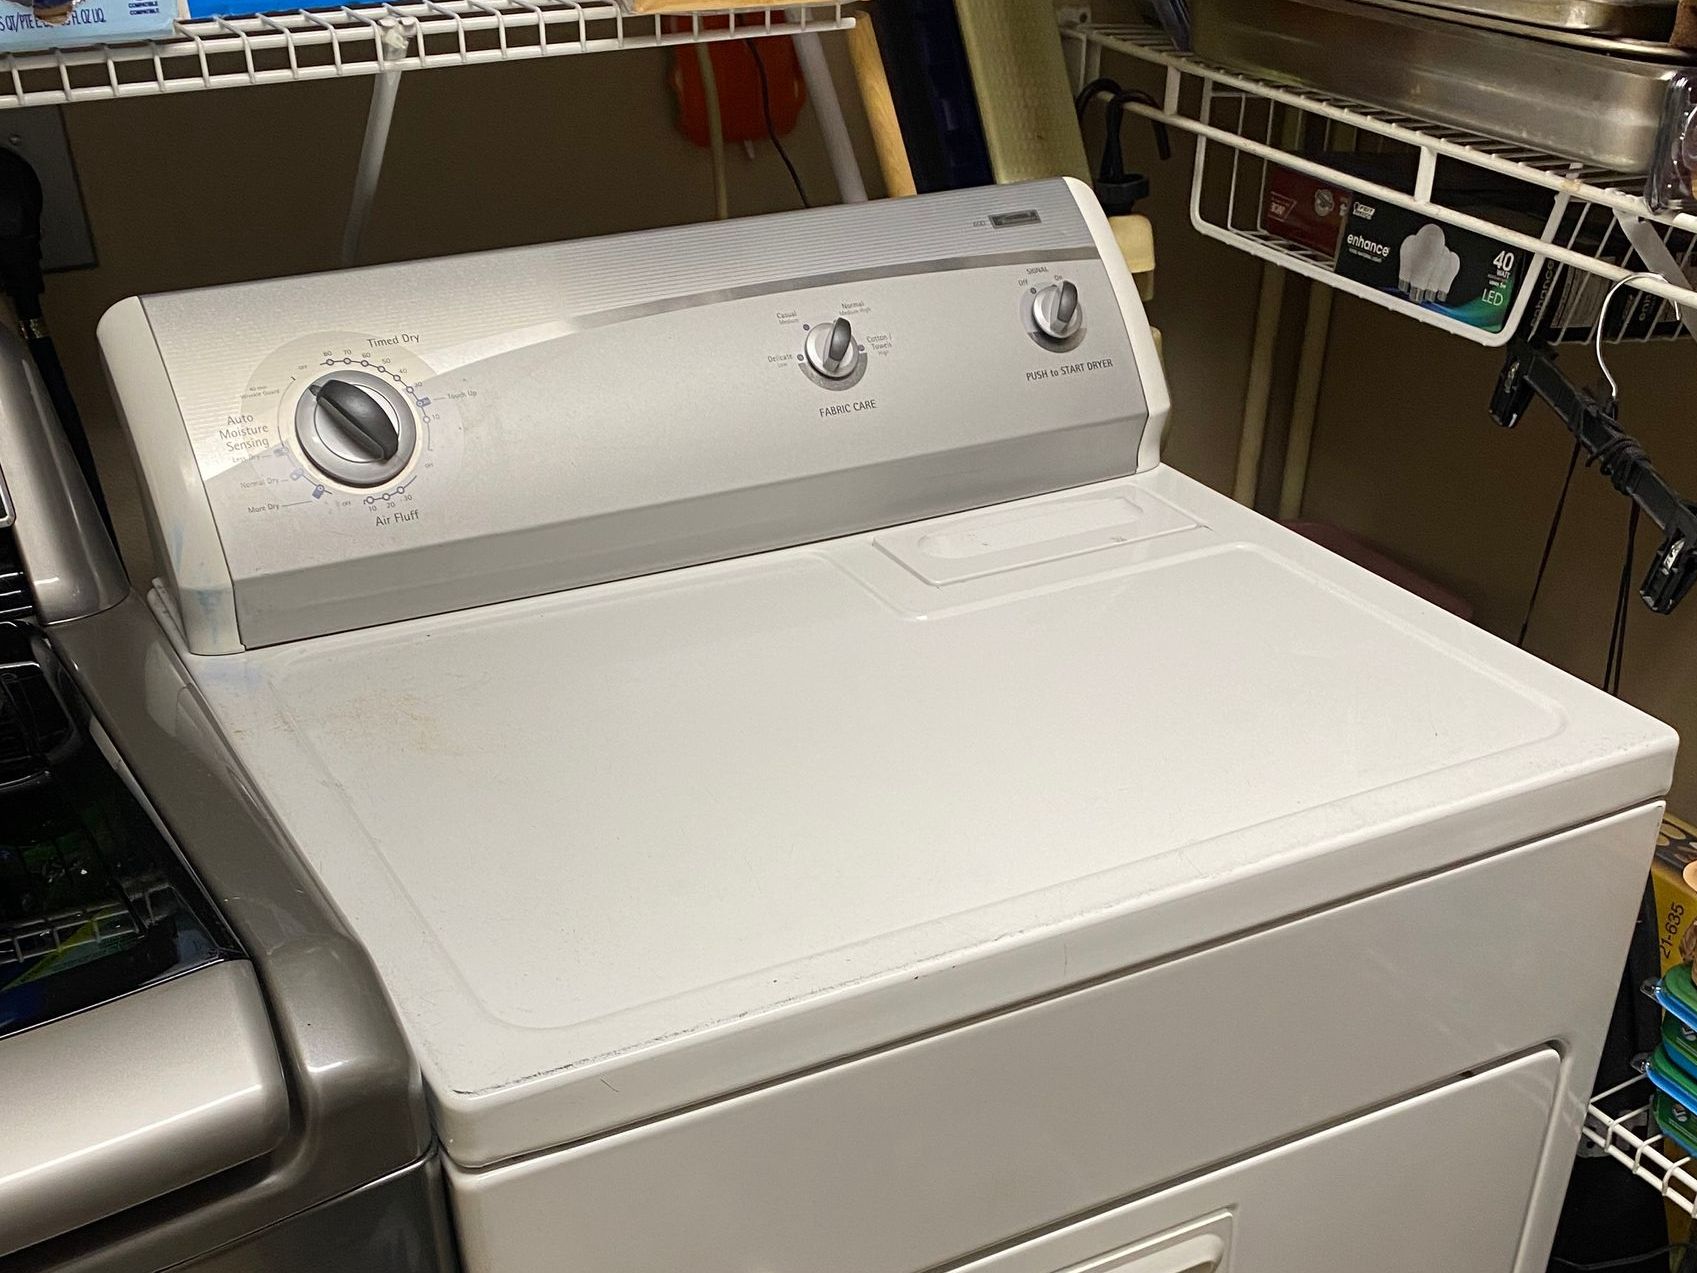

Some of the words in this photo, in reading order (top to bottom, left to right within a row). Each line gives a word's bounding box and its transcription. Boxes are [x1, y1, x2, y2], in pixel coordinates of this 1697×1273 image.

[1346, 233, 1390, 257] enhance
[1492, 250, 1516, 272] 40
[1481, 287, 1504, 306] LED
[367, 336, 399, 349] Timed
[401, 332, 420, 345] Dry
[381, 357, 391, 365] 50
[768, 354, 793, 363] Delicate
[1026, 371, 1049, 381] PUSH
[1050, 369, 1060, 378] to
[1060, 363, 1086, 376] START
[1086, 358, 1114, 372] DRYER
[432, 413, 441, 421] 10
[819, 403, 851, 418] FABRIC
[852, 399, 877, 412] CARE
[227, 414, 254, 426] Auto
[218, 424, 270, 441] Moisture
[226, 437, 270, 453] Sensing
[368, 504, 377, 513] 10
[386, 501, 396, 509] 20
[375, 514, 391, 527] Air
[393, 509, 420, 524] Fluff
[1660, 901, 1684, 959] 21-635
